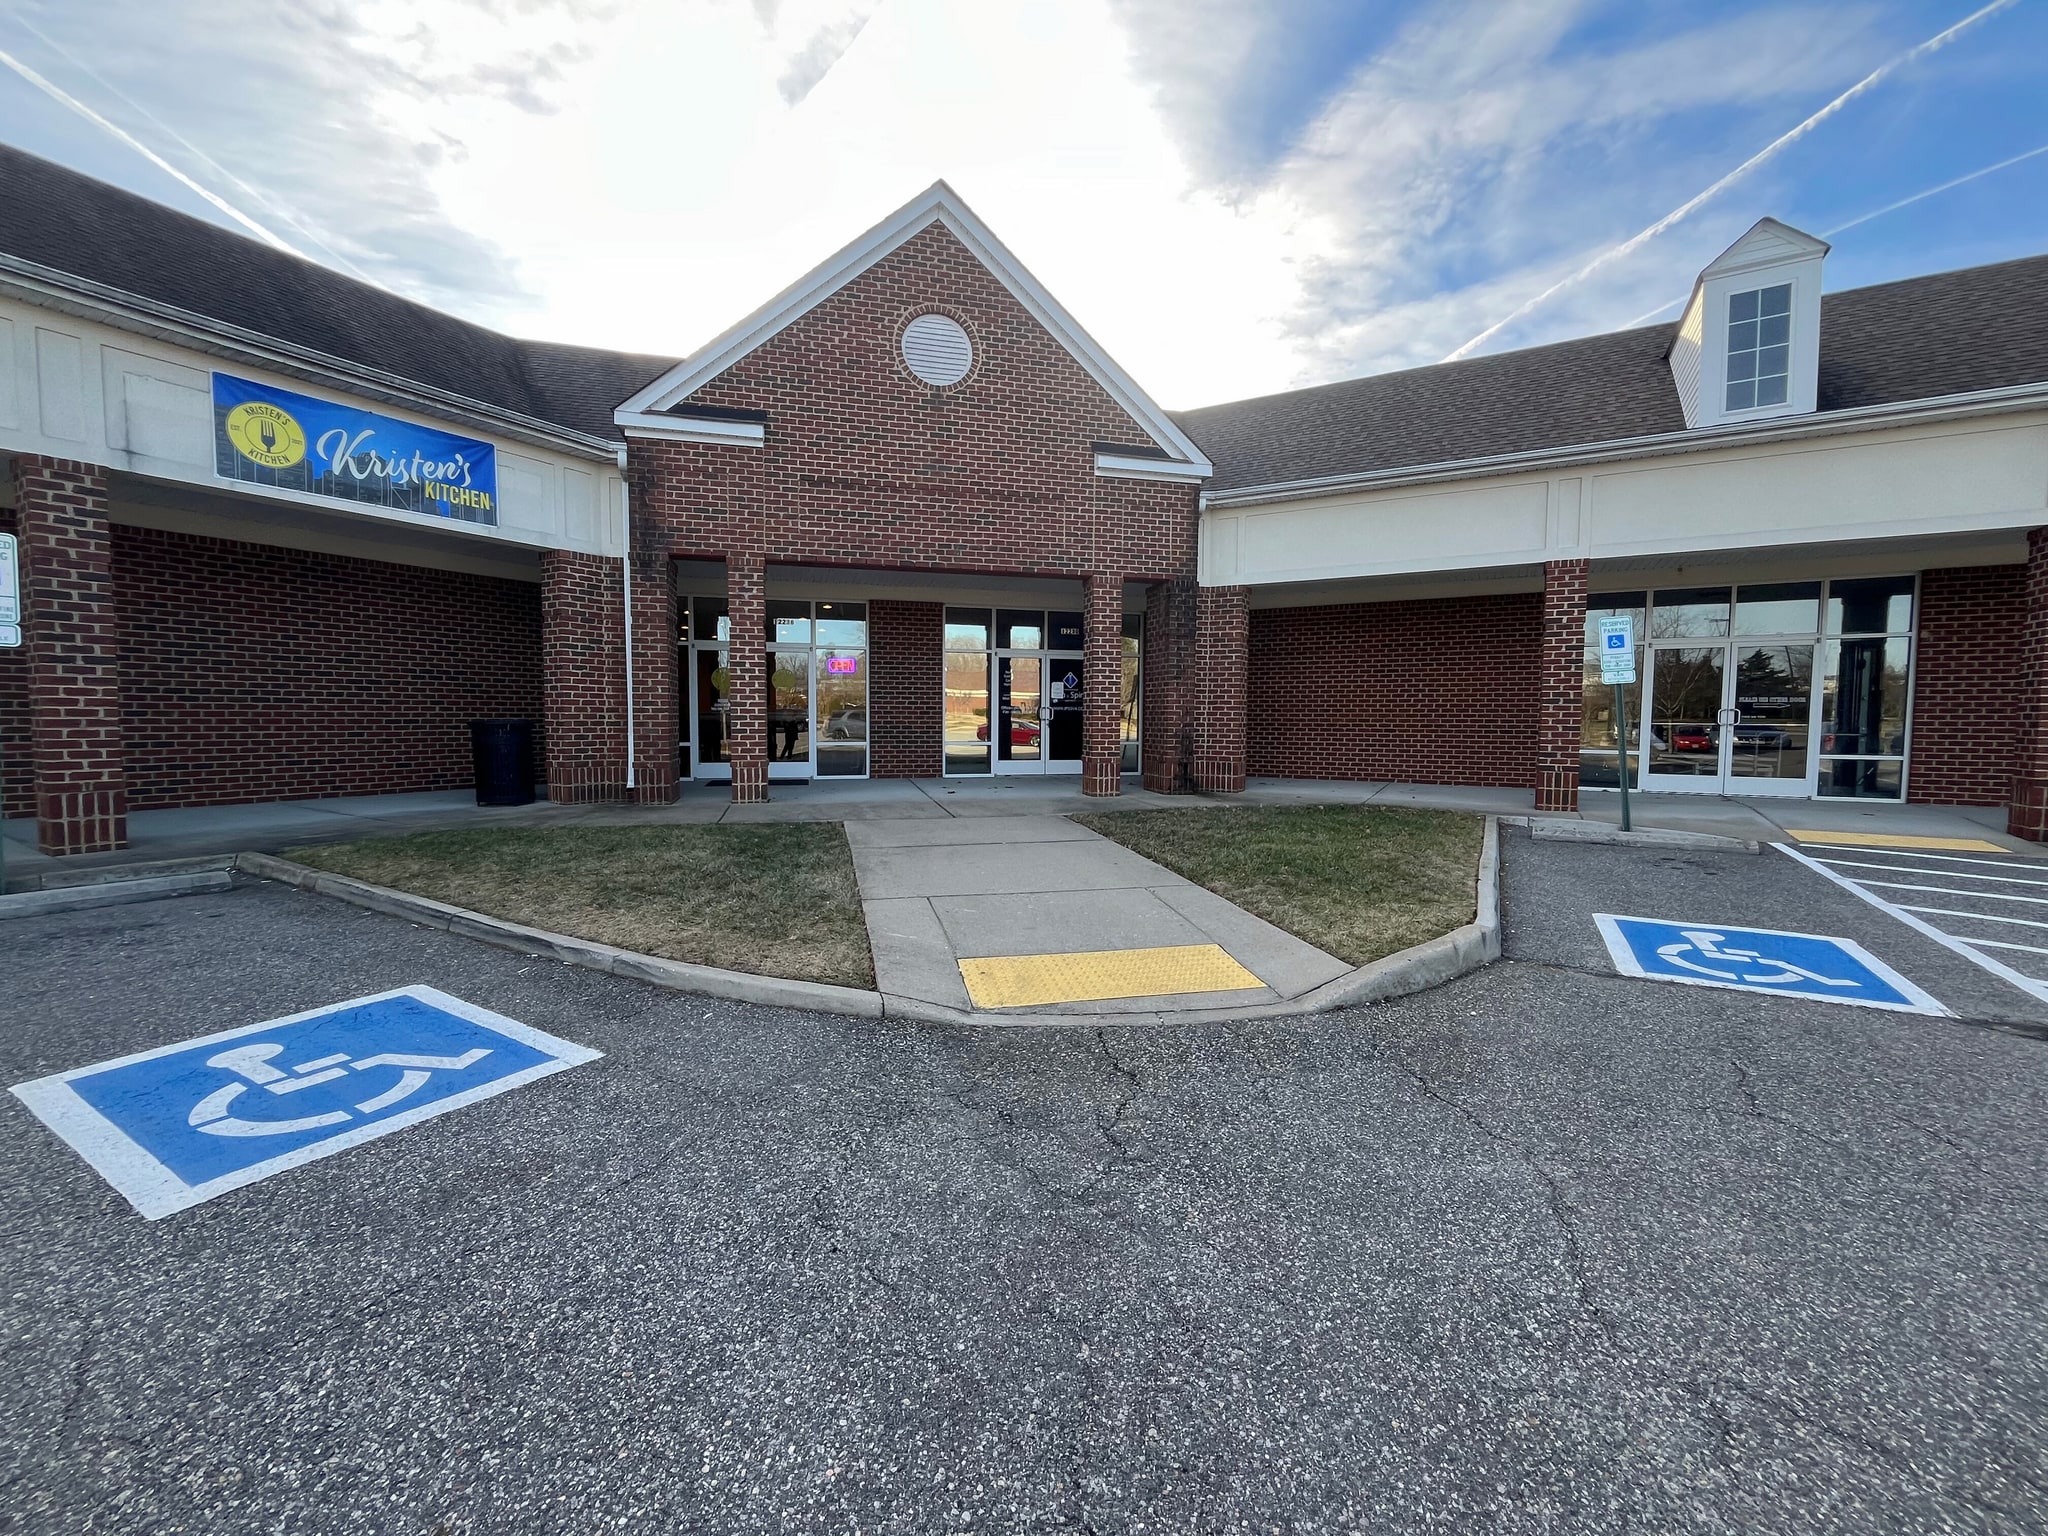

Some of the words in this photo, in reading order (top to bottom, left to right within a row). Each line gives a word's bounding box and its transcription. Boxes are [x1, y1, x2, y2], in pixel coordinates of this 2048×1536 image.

[243, 406, 291, 426] KRISTEN'S
[248, 448, 291, 466] KITCHEN
[316, 429, 472, 488] Kristen's
[425, 479, 491, 511] KITCHEN
[830, 660, 853, 672] OPEN
